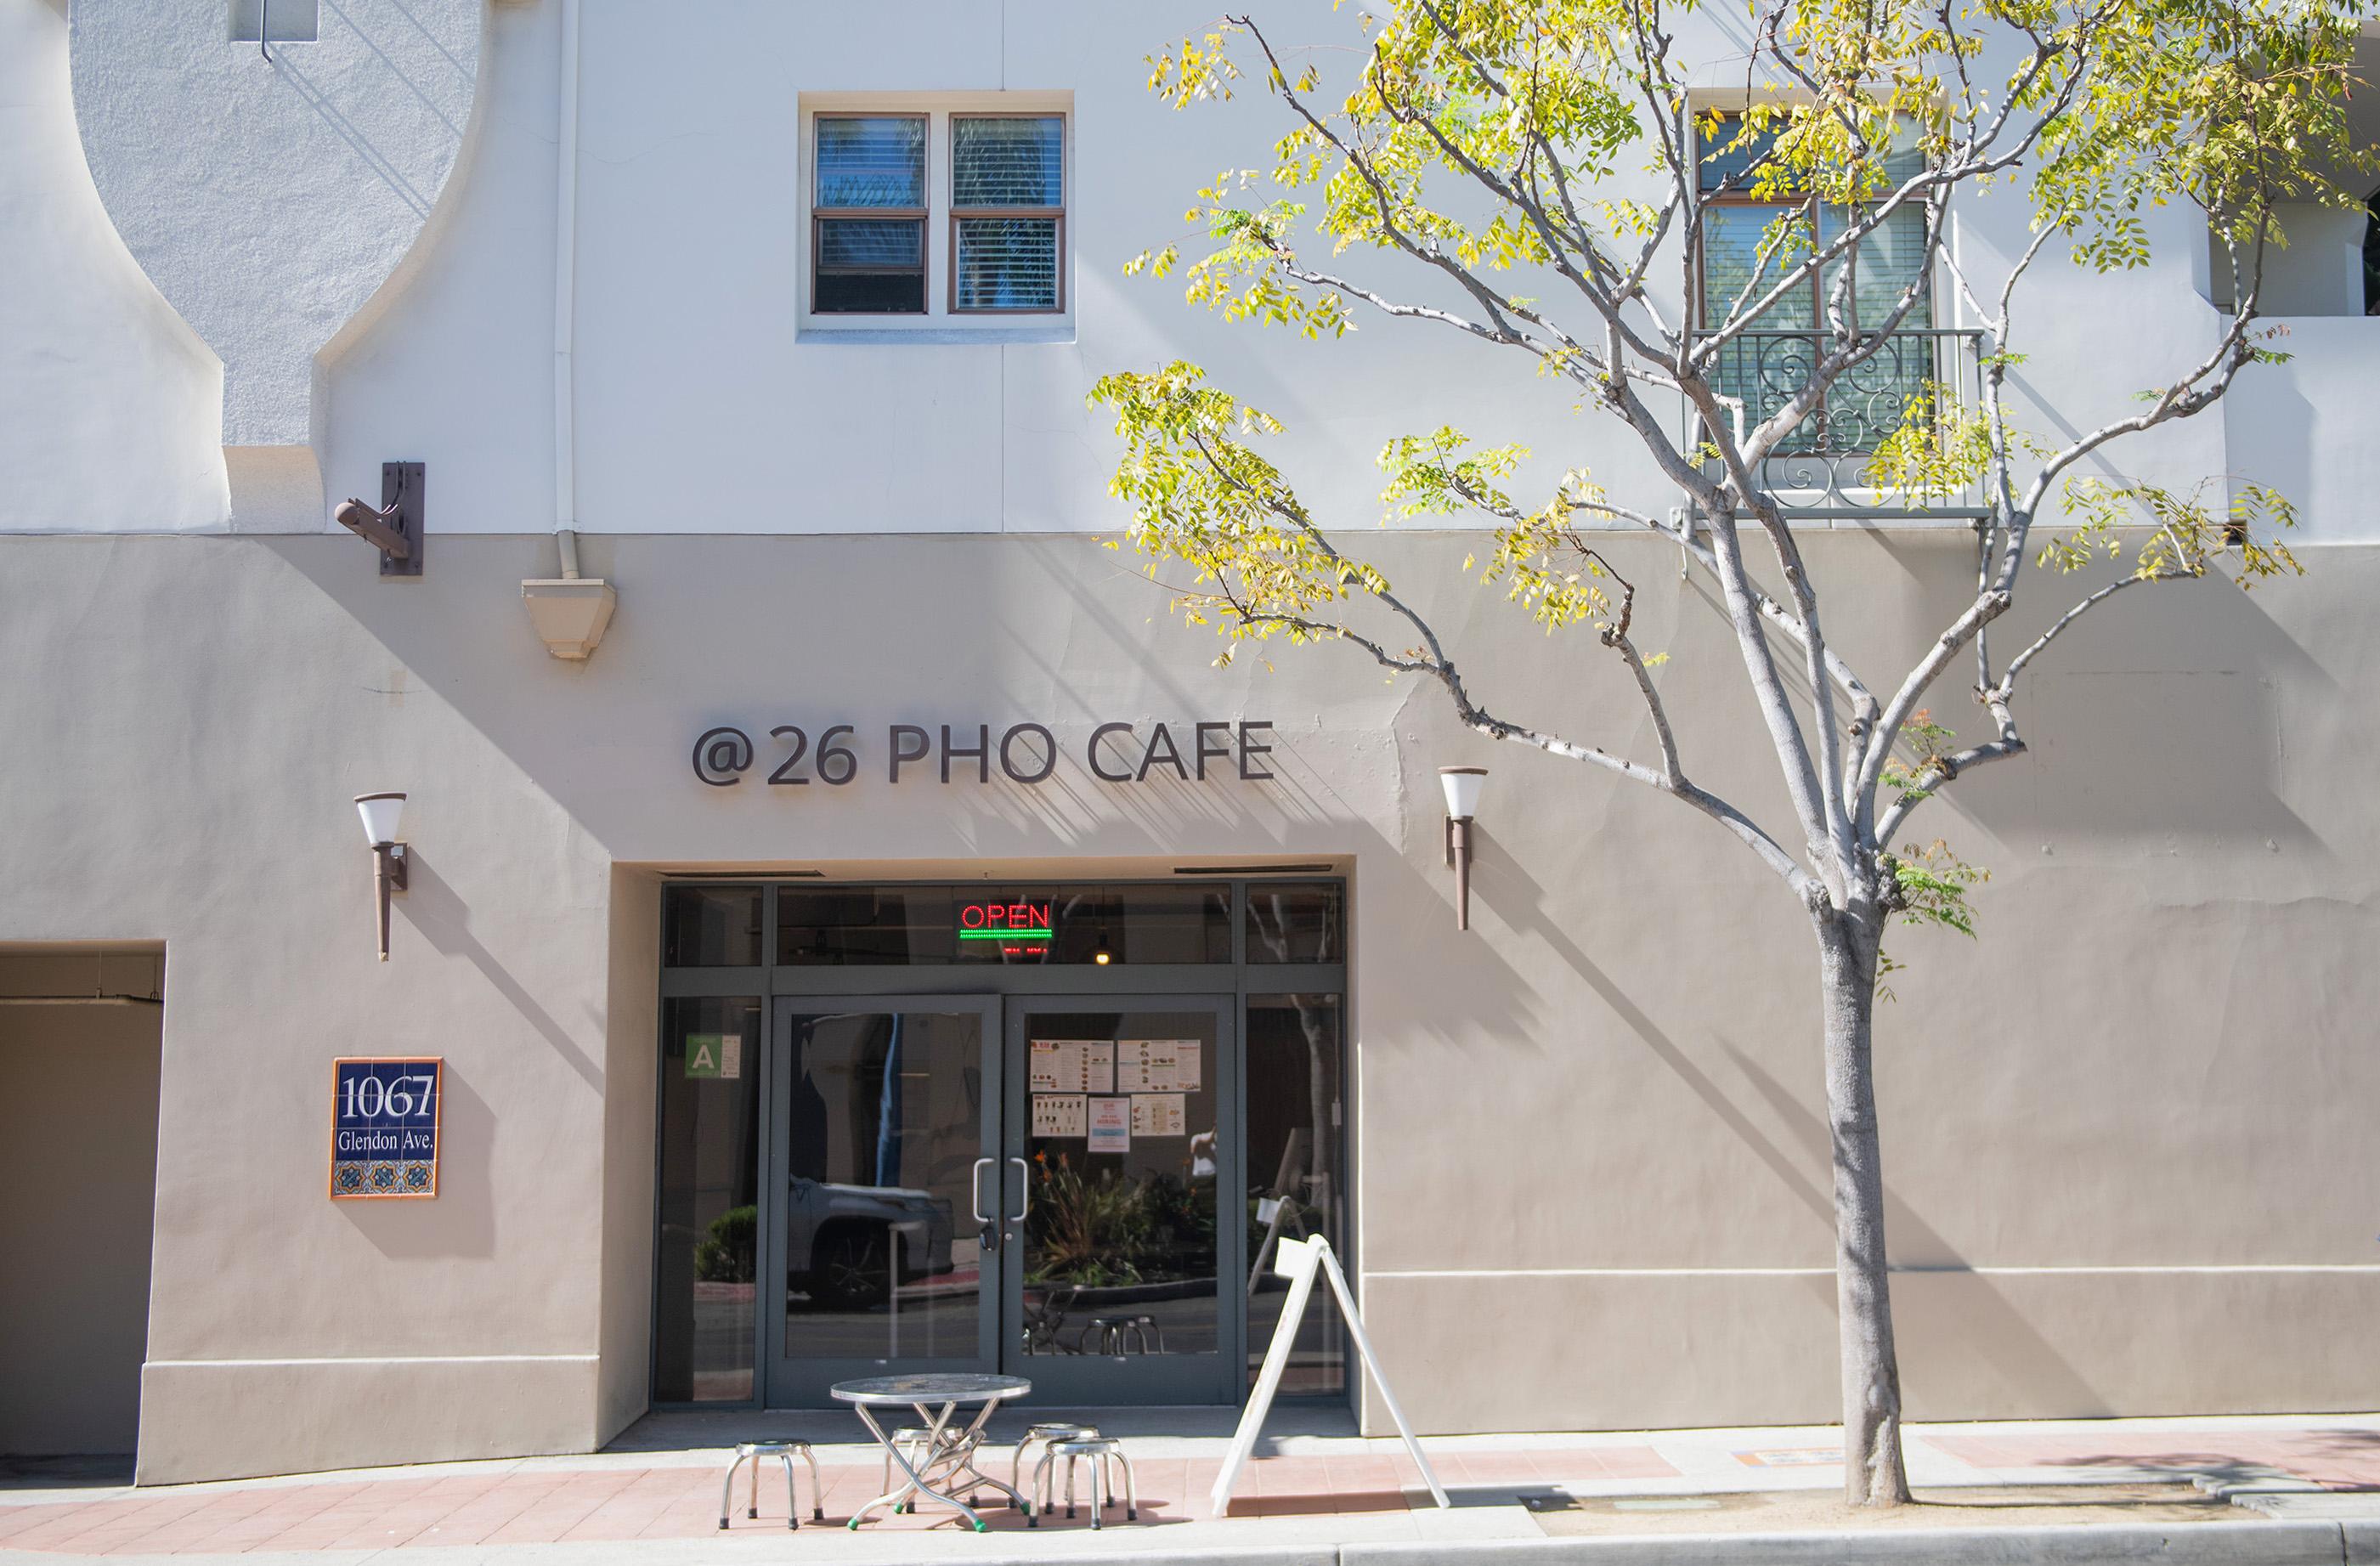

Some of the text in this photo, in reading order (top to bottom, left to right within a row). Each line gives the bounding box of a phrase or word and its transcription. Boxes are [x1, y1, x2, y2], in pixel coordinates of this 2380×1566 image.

[692, 721, 1274, 786] @26 PHO CAFE
[961, 904, 1049, 929] OPEN
[693, 1044, 715, 1069] A
[342, 1075, 434, 1118] 1067
[338, 1130, 433, 1150] Glendon Ave.
